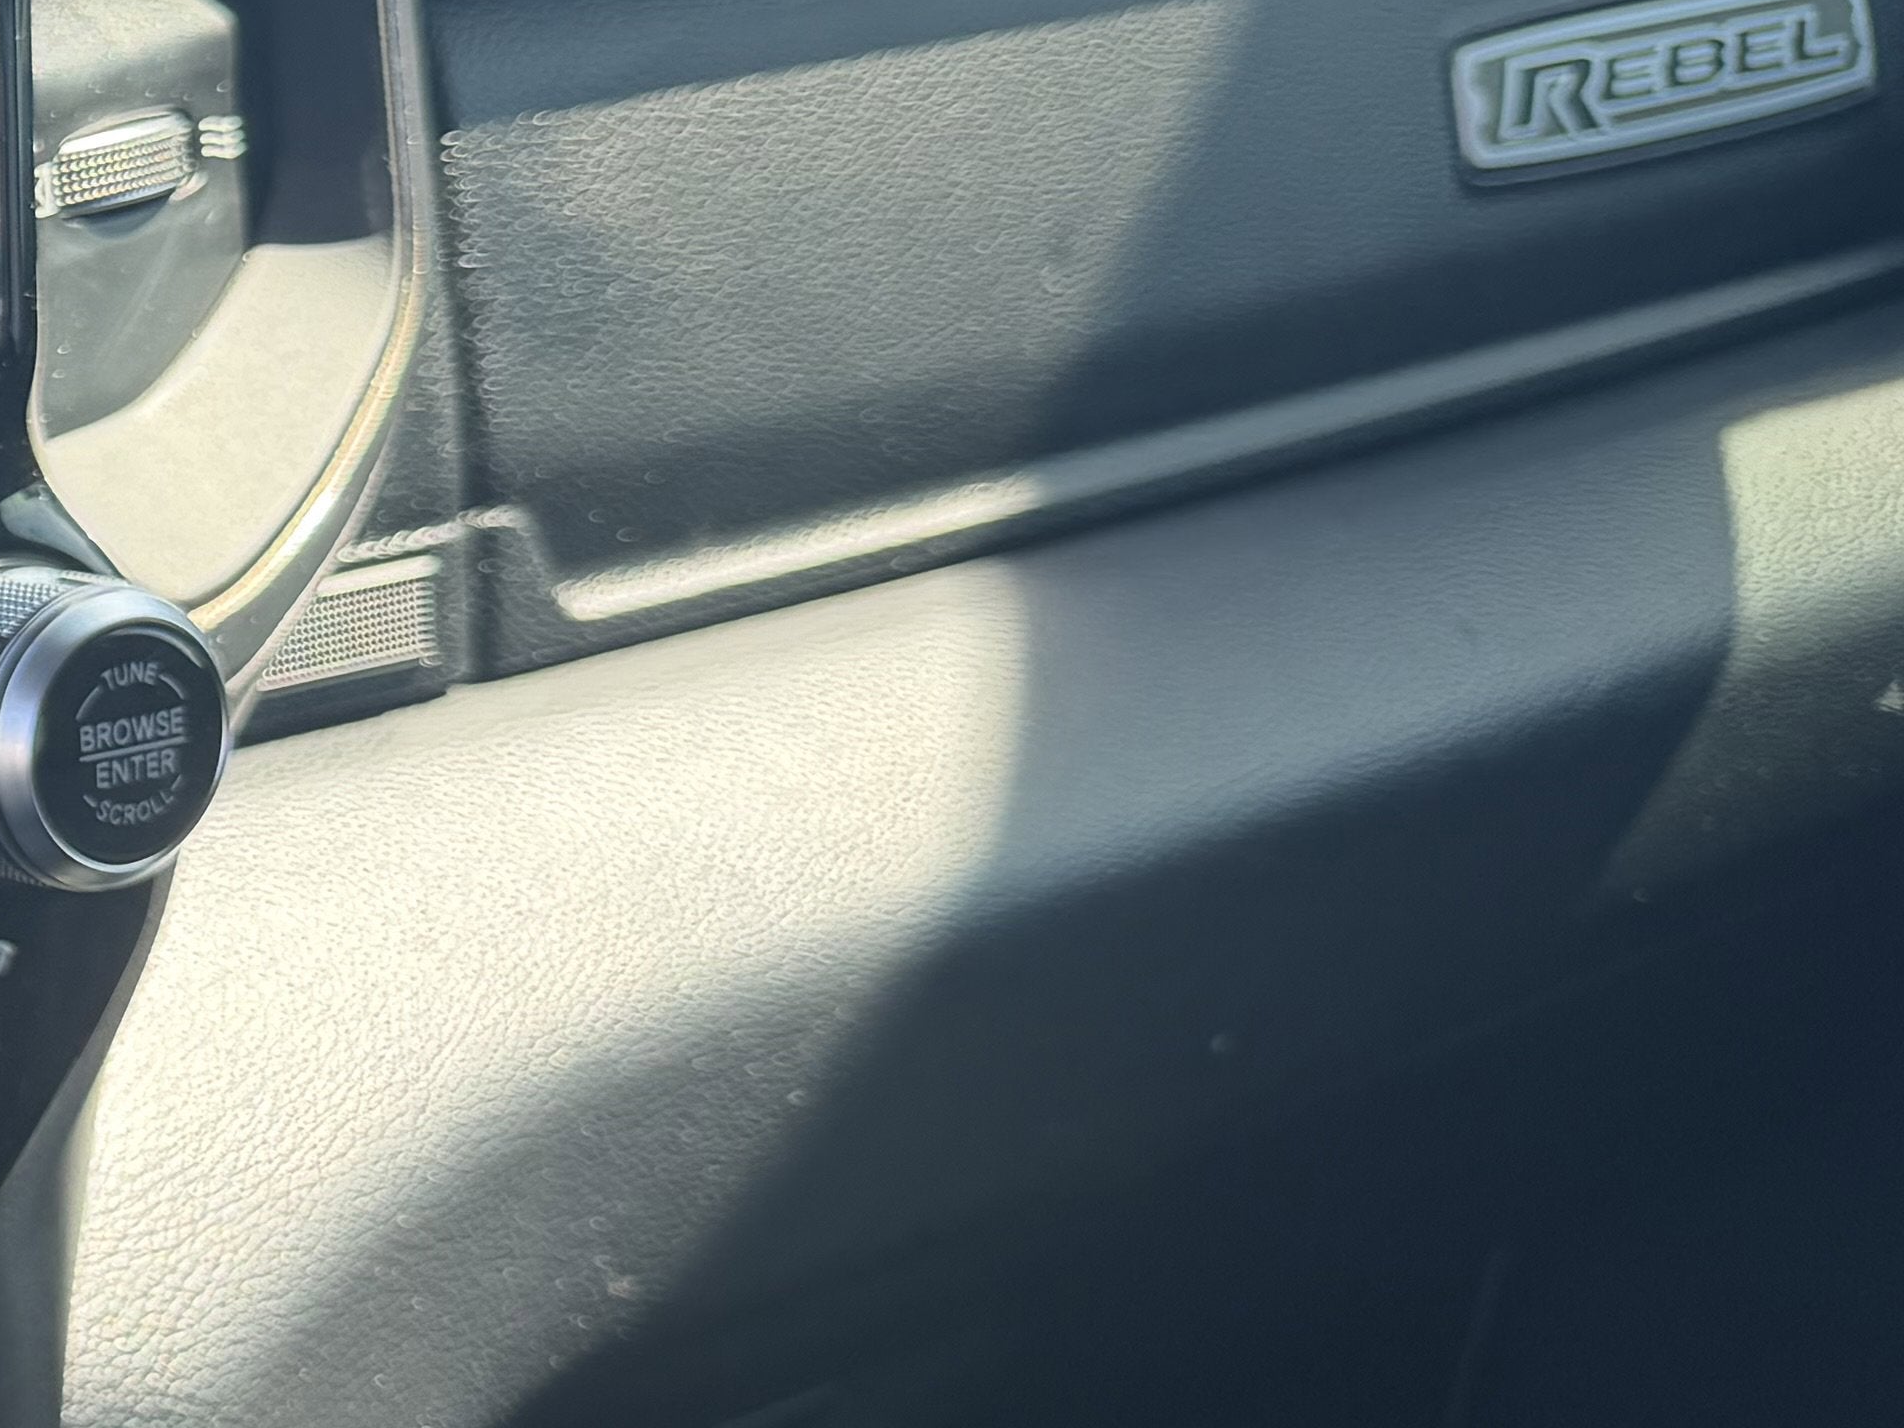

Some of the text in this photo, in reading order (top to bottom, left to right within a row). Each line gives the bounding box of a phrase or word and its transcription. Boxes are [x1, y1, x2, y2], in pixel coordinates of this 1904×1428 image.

[1498, 4, 1850, 143] REBEL
[101, 661, 160, 690] TUNE
[80, 706, 187, 752] BROWSE
[96, 748, 175, 790] ENTER
[93, 788, 175, 828] SCROLL
